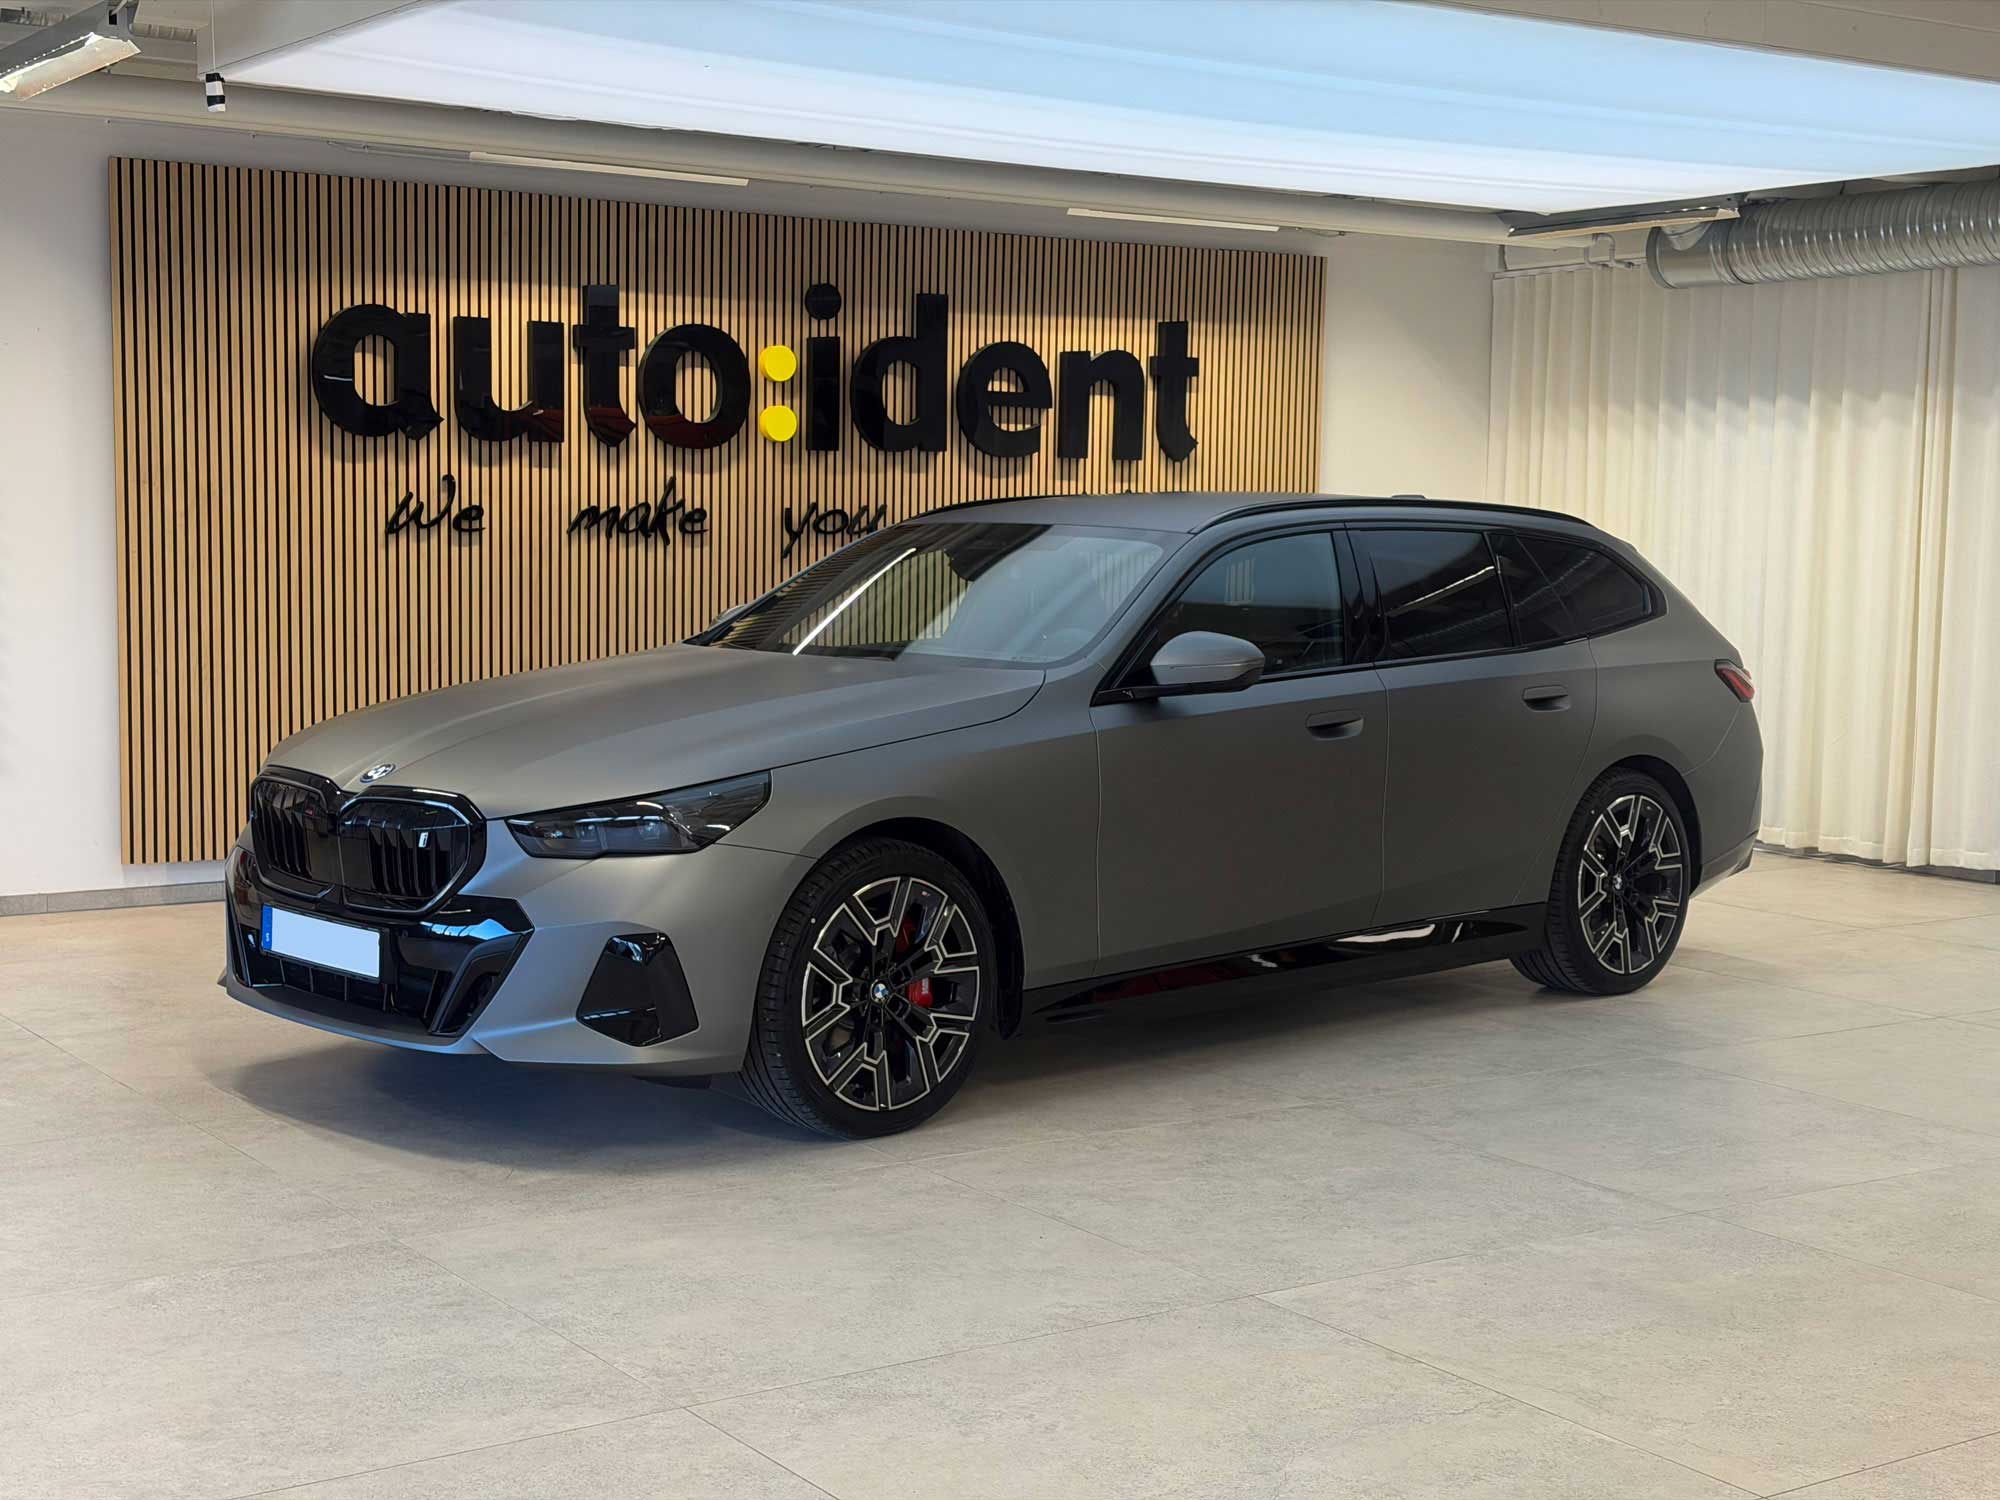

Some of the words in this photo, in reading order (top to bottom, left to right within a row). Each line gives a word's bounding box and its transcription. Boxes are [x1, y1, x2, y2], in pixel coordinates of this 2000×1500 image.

[311, 283, 1199, 462] auto:ident
[566, 475, 710, 546] make
[782, 502, 888, 559] you
